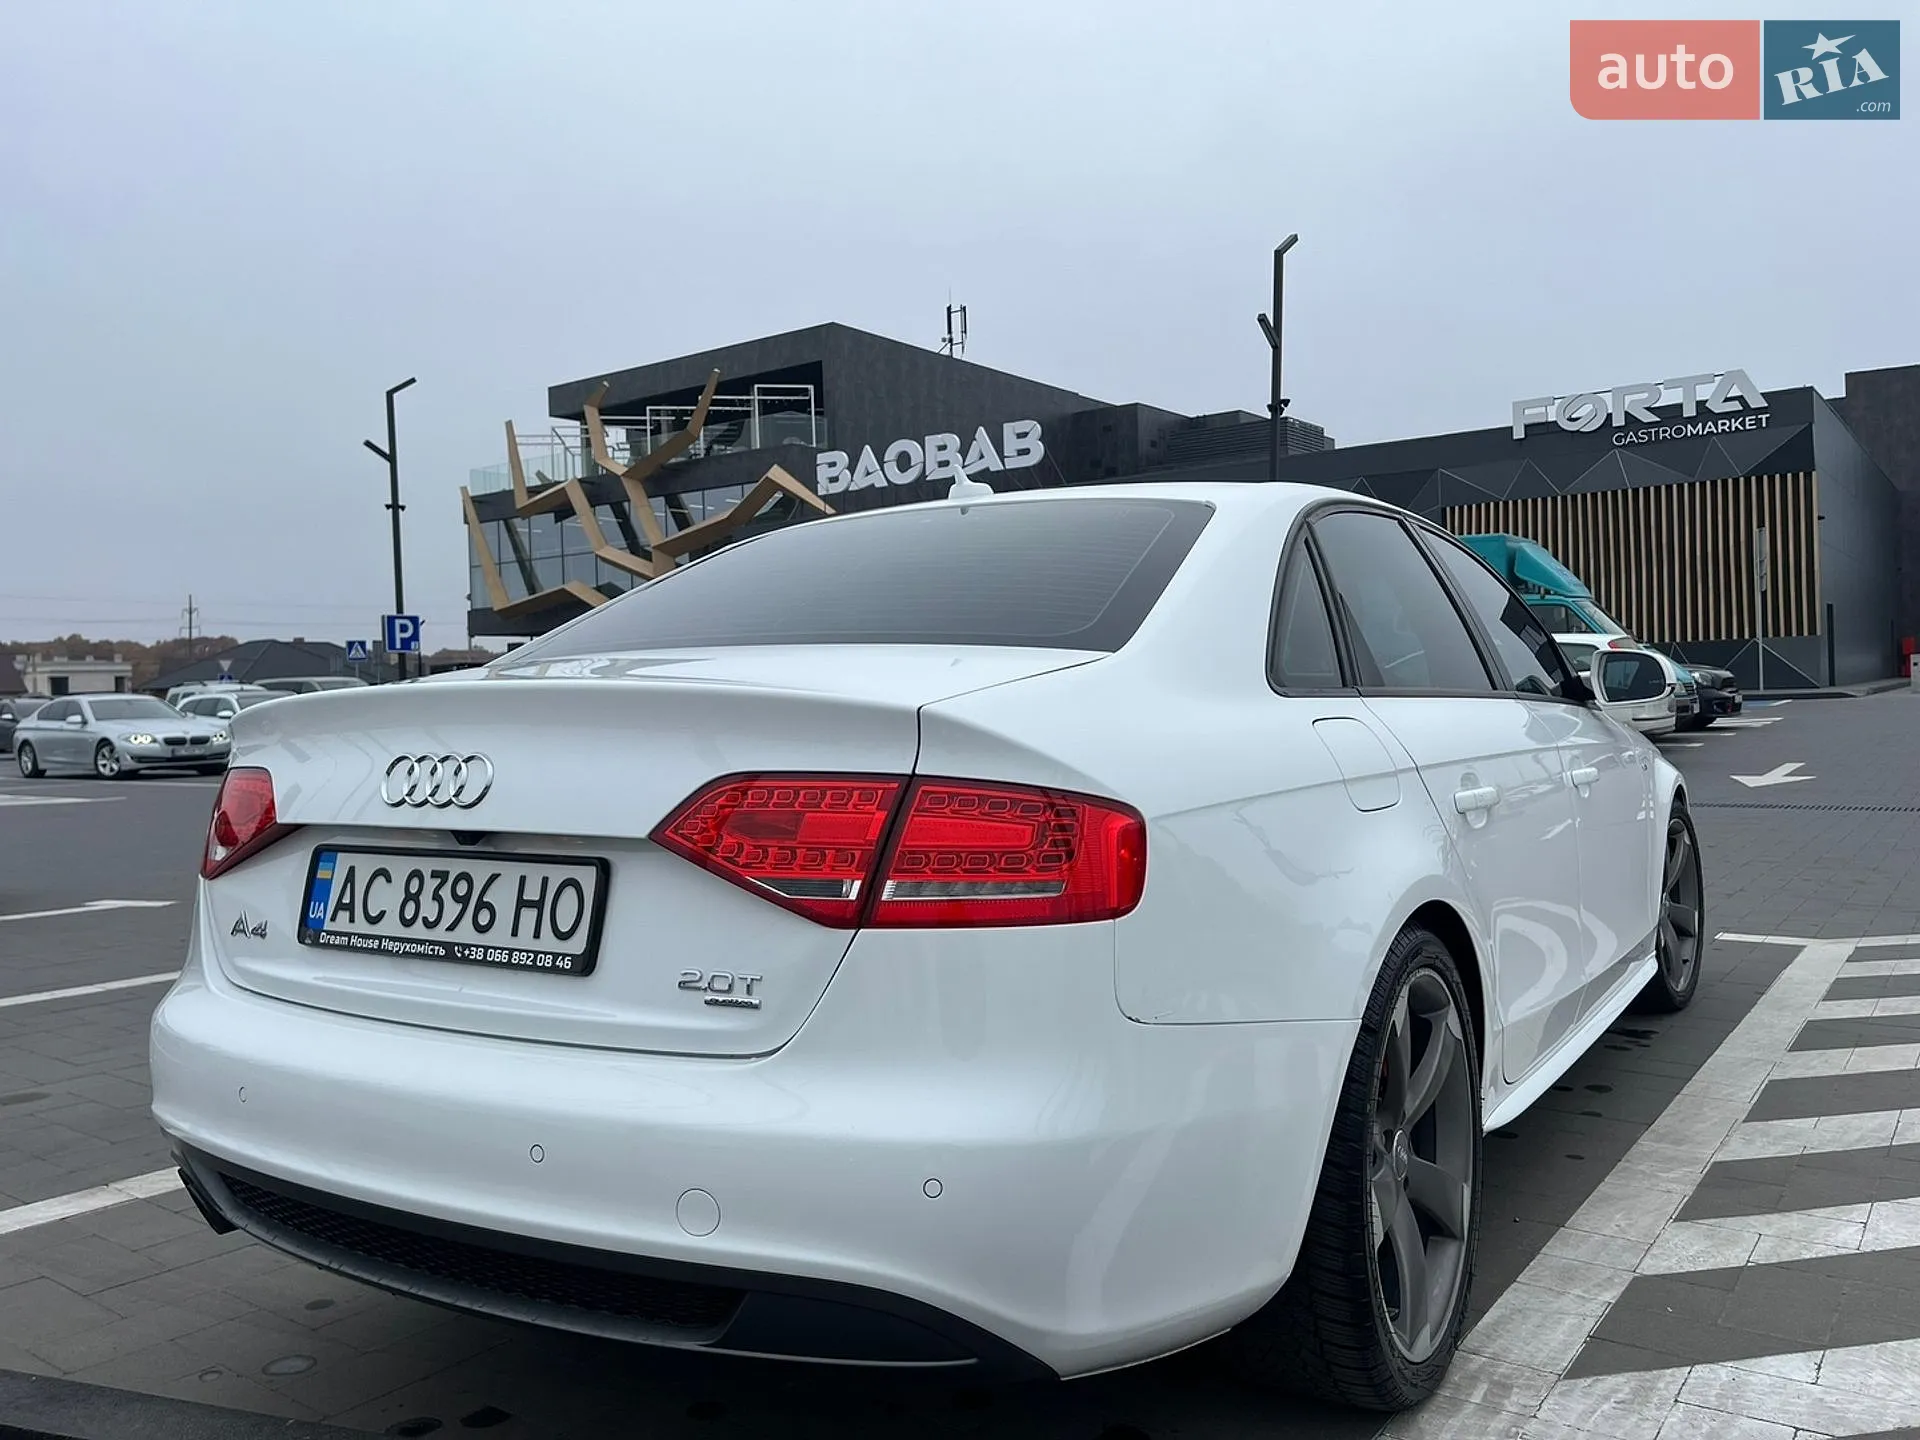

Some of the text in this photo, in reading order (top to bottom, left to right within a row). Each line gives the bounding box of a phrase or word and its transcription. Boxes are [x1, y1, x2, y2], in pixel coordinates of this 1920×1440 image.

[1511, 368, 1769, 440] FORTA
[1612, 413, 1770, 446] GASTROMARKET
[816, 419, 1045, 496] BAOBAB
[394, 618, 414, 649] P
[309, 900, 324, 919] UA
[330, 865, 585, 941] AC 8396 HO
[230, 910, 268, 940] A4
[319, 931, 572, 969] Dream House Нерухомість +38 066 892 08 46
